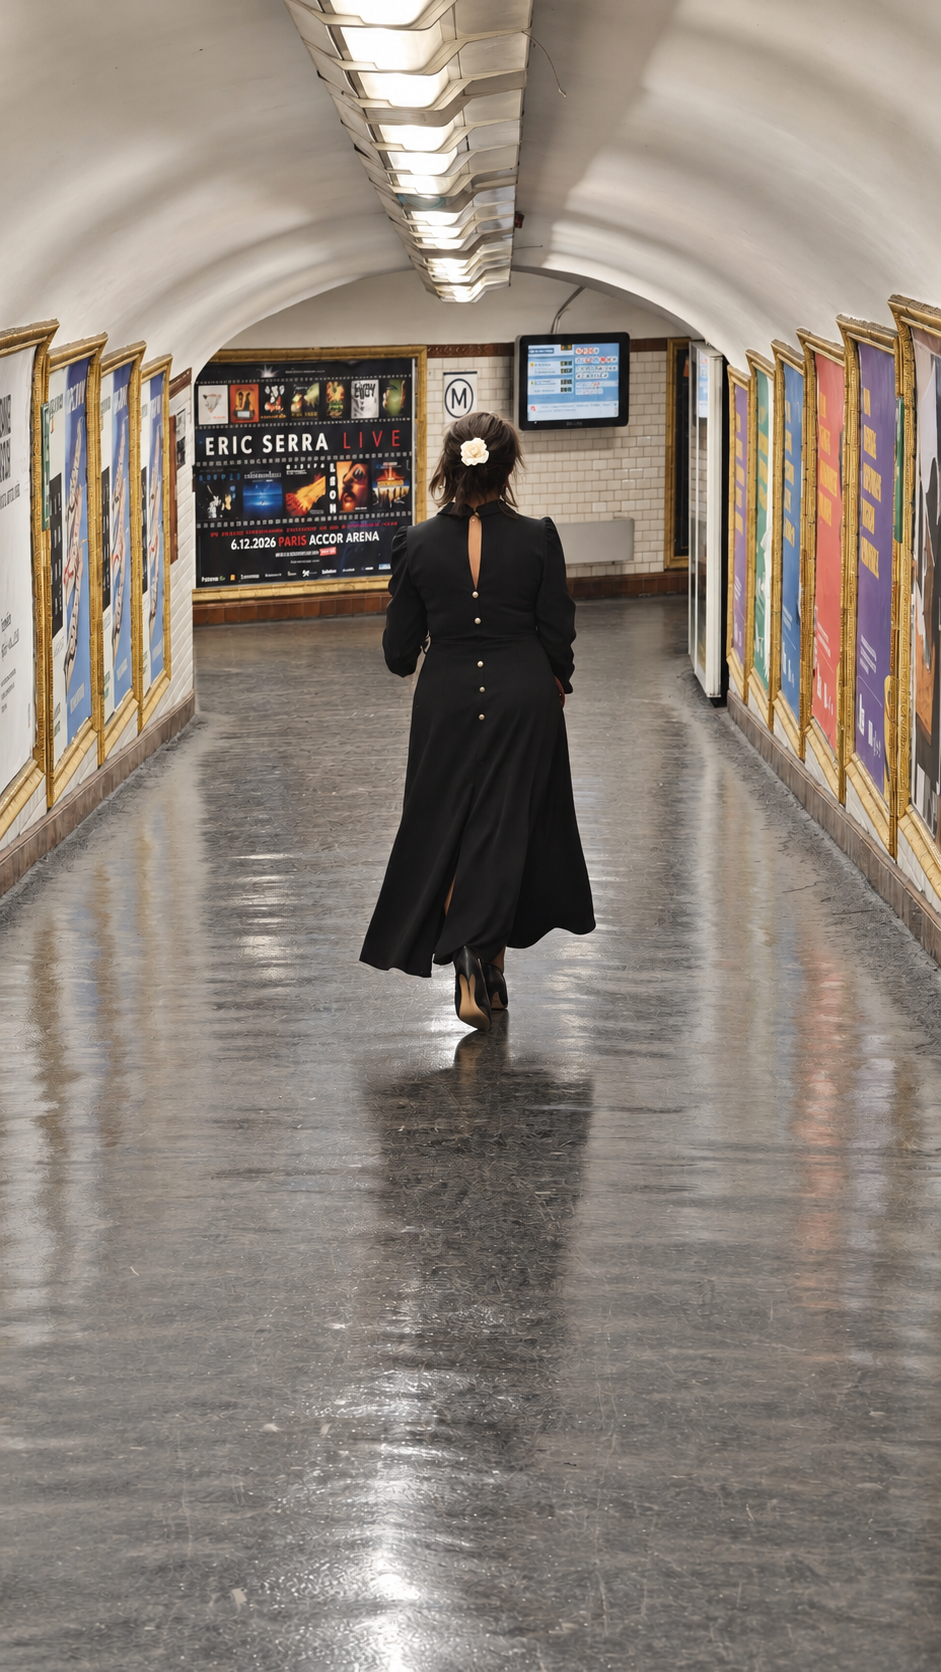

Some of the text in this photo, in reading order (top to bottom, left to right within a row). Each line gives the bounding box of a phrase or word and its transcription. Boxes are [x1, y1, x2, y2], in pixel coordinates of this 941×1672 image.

[451, 387, 467, 409] M
[205, 430, 401, 456] ERIC SERRA LIVE
[230, 530, 380, 551] 6.12.2026 PARIS ACCOR ARENA
